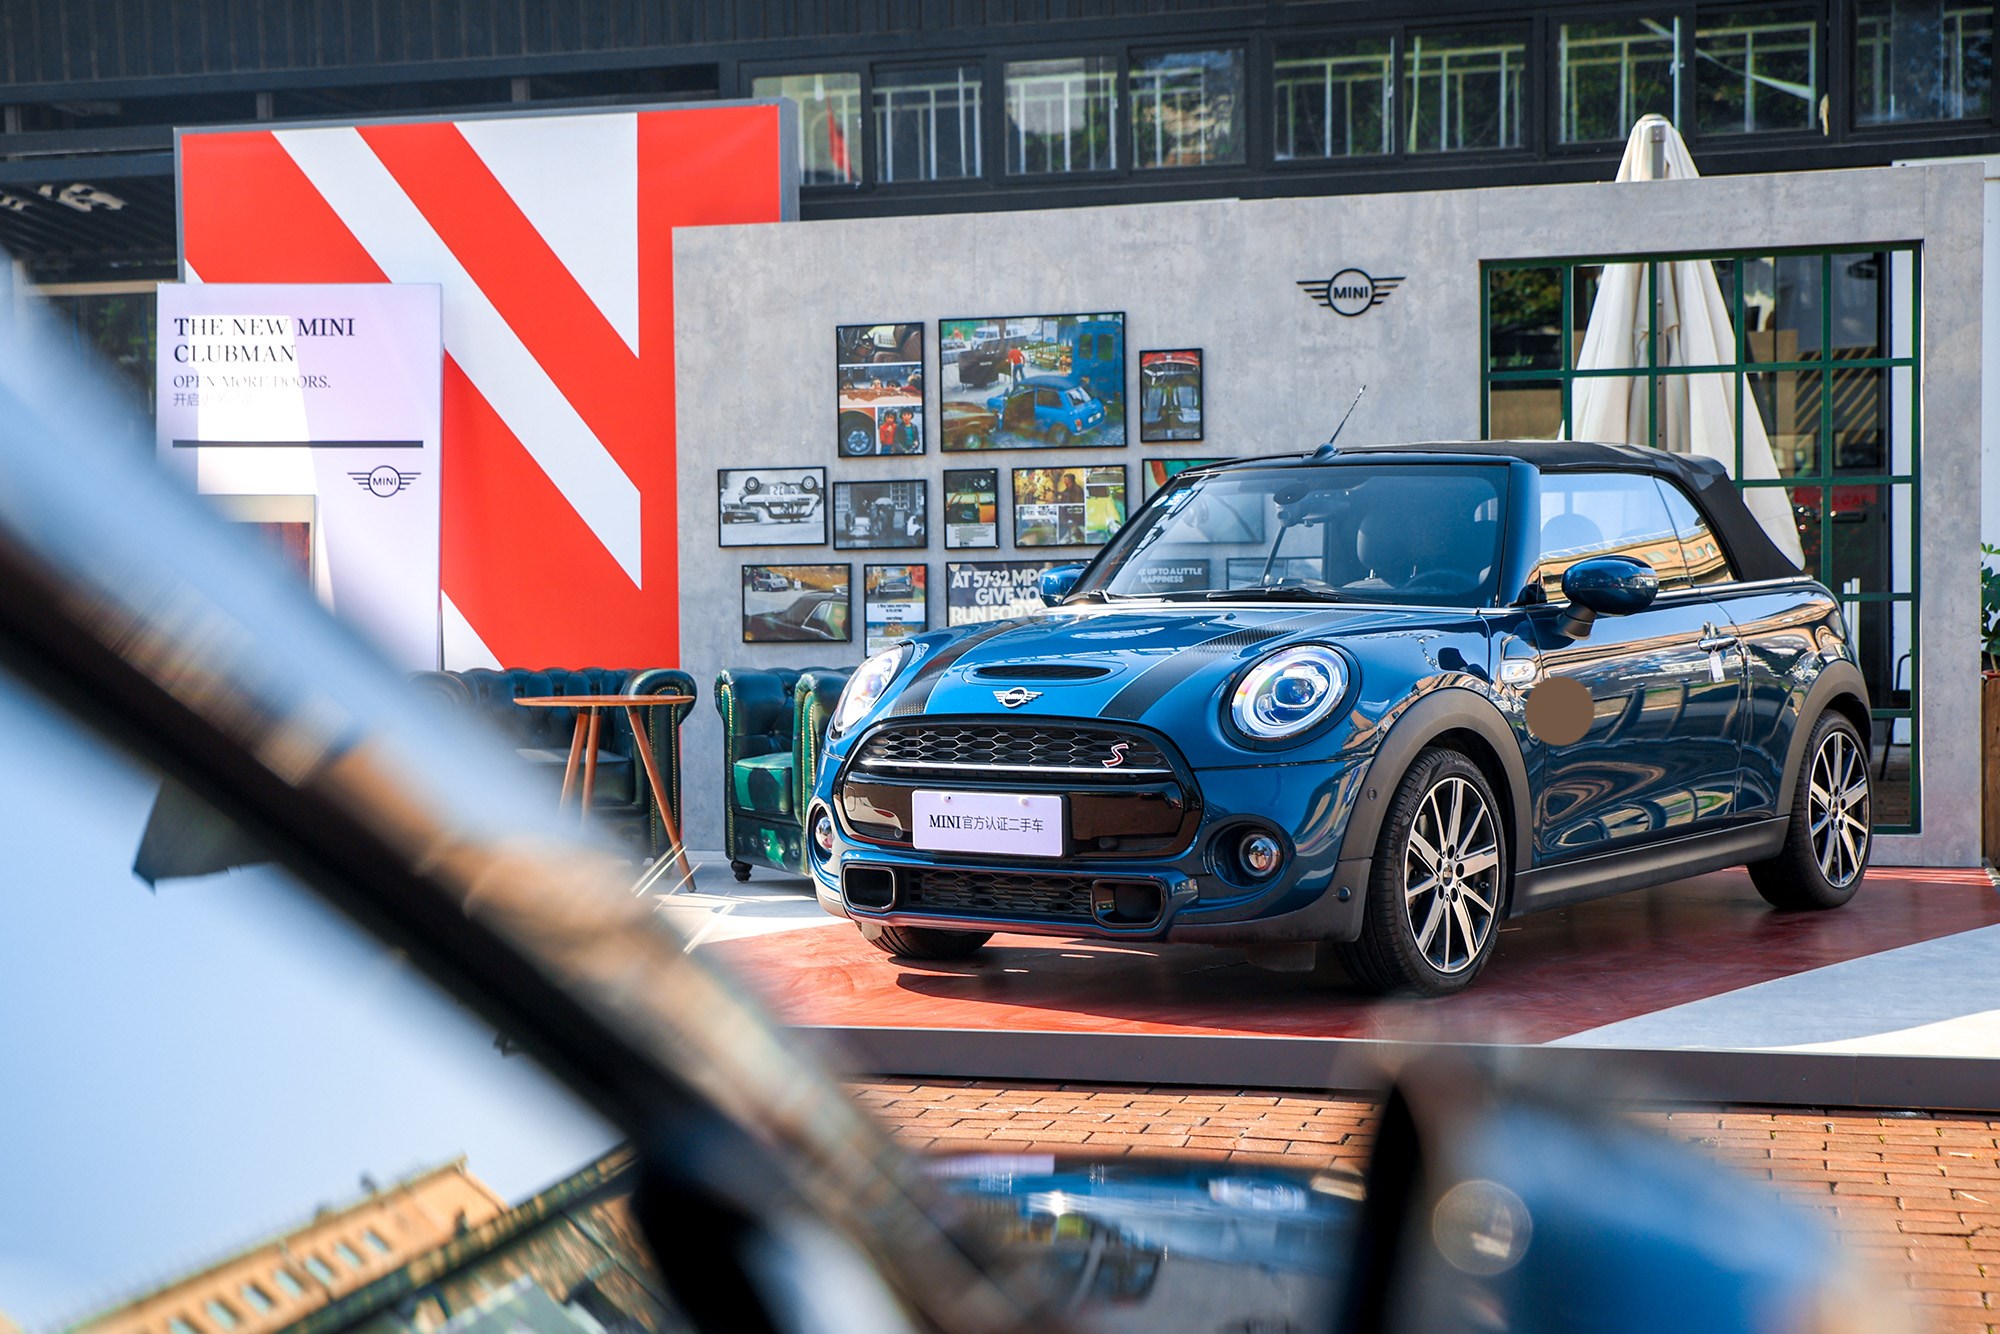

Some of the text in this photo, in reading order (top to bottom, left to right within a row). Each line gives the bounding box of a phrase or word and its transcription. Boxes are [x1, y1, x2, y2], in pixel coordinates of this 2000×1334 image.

[1333, 286, 1369, 299] MINI
[174, 318, 356, 336] THE NEW MINI
[174, 344, 297, 363] CLUBMAN
[173, 375, 216, 388] OPEN
[274, 375, 331, 389] DOORS.
[373, 477, 397, 486] MINI
[951, 571, 972, 588] AT
[1141, 575, 1184, 583] HAPPINESS
[1158, 567, 1169, 575] TO
[1176, 567, 1203, 575] LITTLE
[975, 587, 1015, 605] GIVE
[950, 606, 986, 624] RUN
[1101, 743, 1129, 769] S
